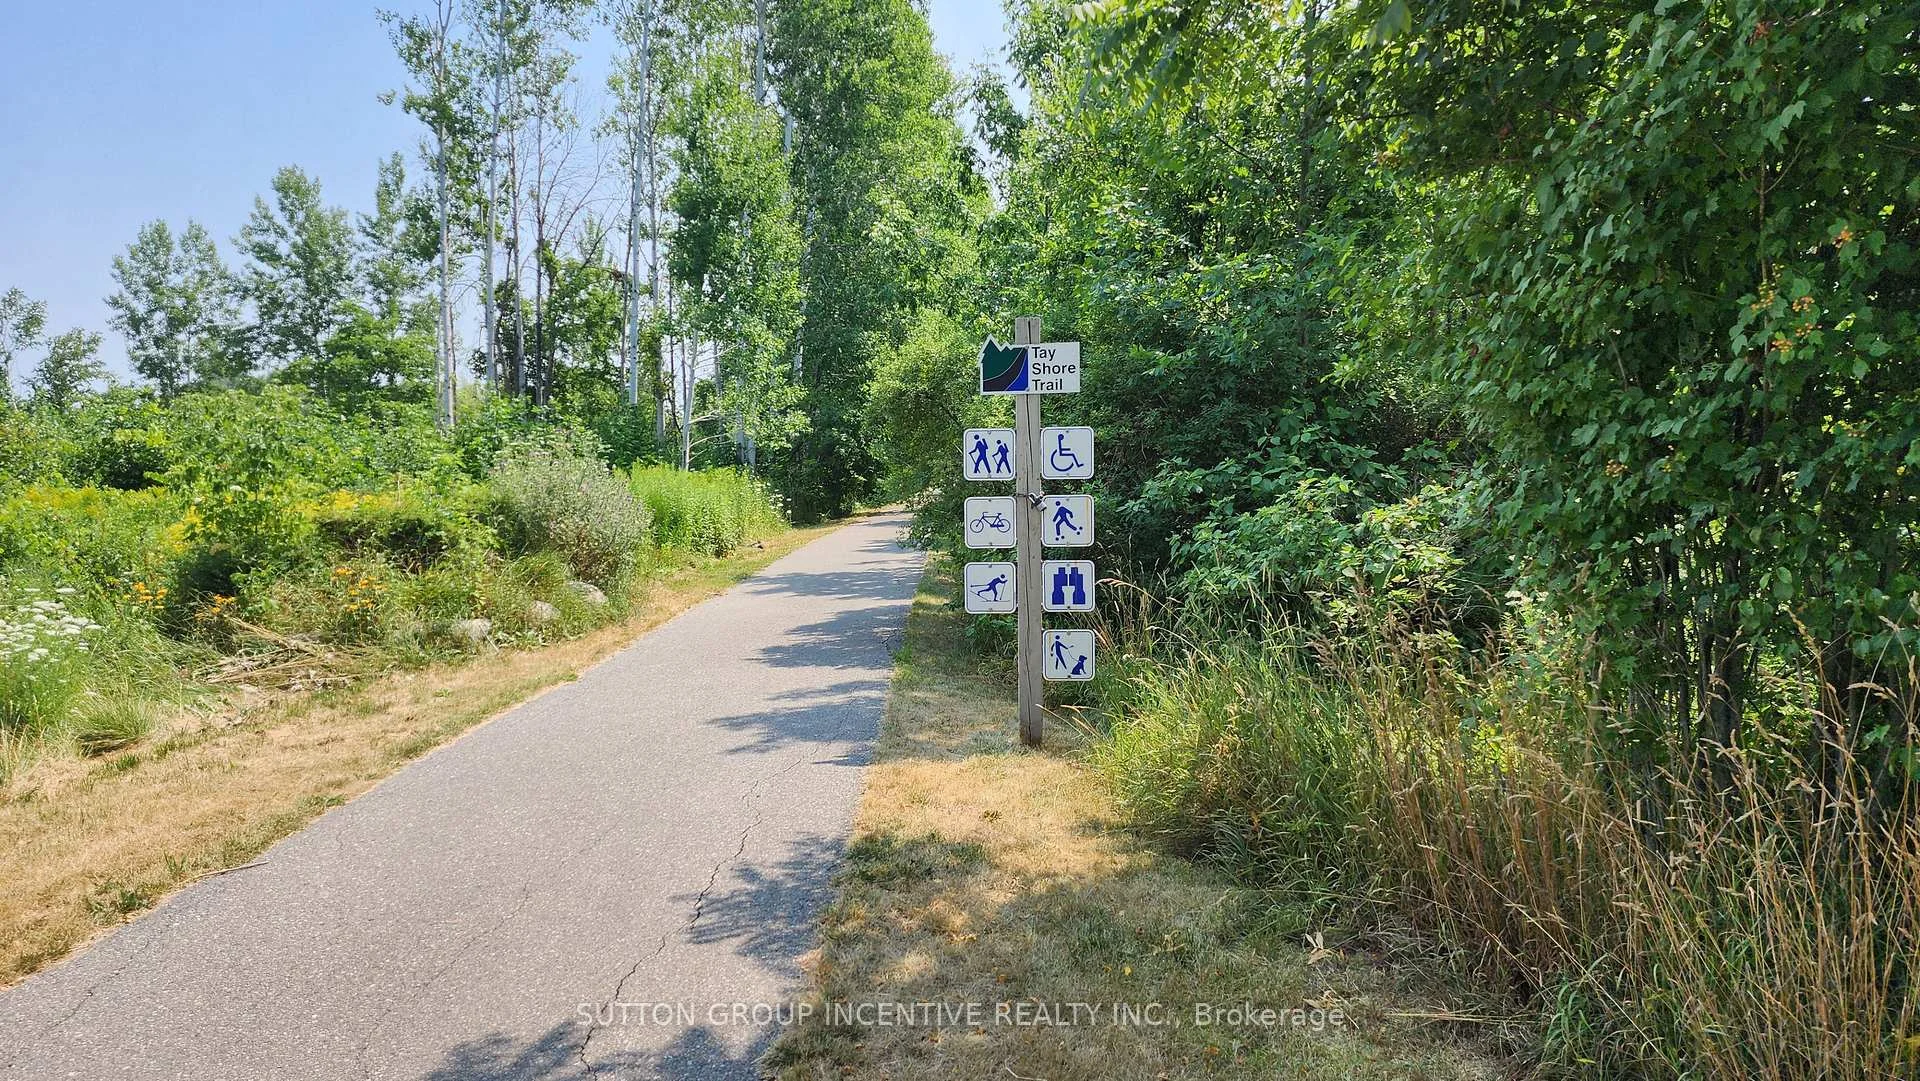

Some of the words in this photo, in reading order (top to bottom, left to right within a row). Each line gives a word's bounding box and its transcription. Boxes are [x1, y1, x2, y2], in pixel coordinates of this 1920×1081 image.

[1032, 346, 1056, 361] Tay
[1032, 362, 1076, 375] Shore
[1032, 378, 1063, 391] Trail
